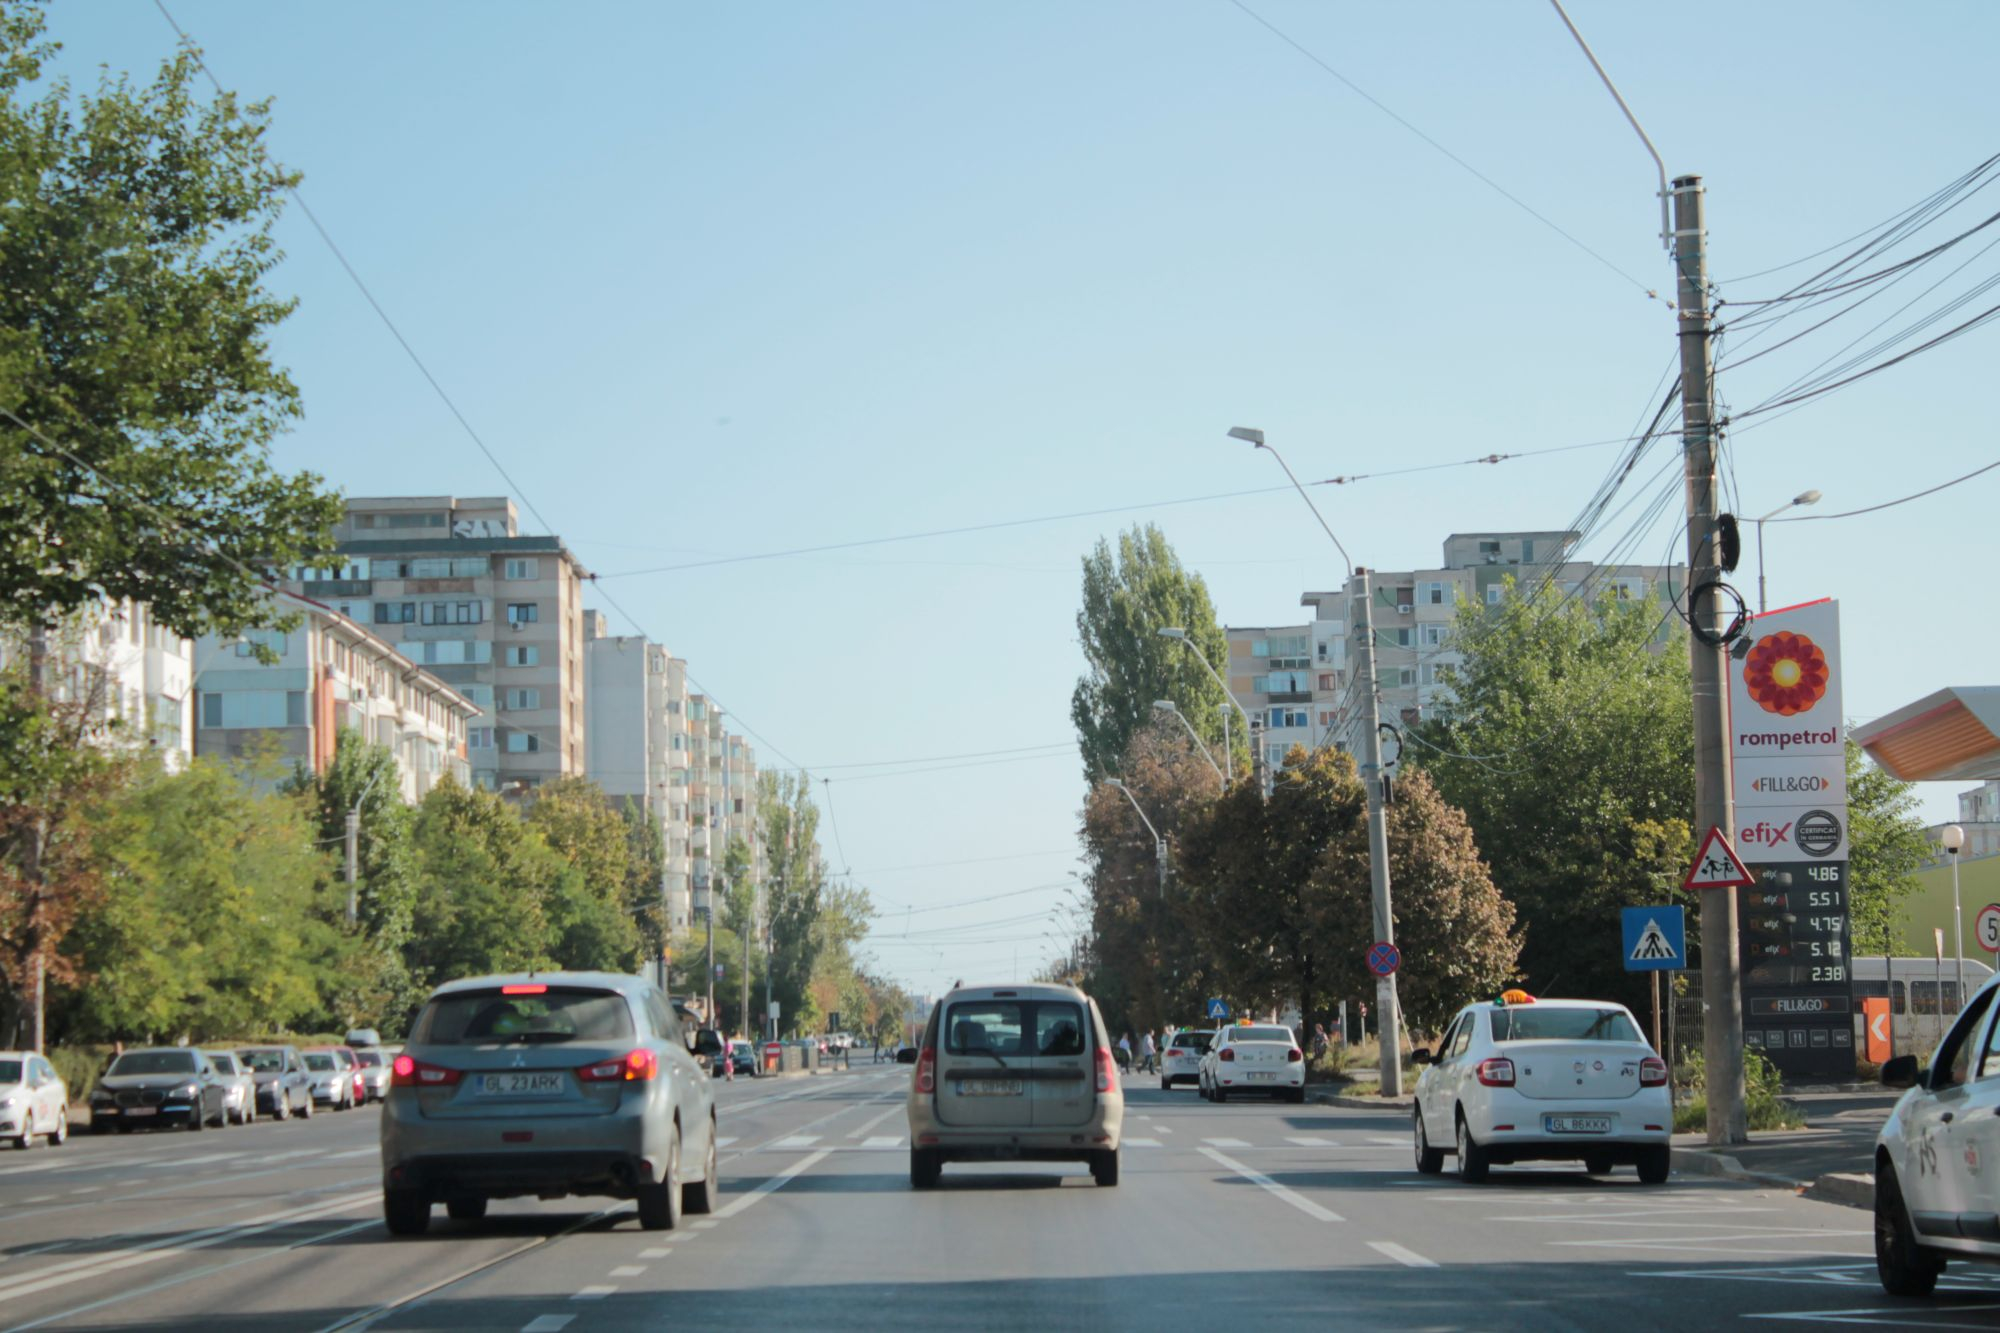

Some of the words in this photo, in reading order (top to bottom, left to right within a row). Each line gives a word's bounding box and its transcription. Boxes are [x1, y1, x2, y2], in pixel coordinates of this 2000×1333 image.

[1740, 727, 1836, 750] rompetrol
[1760, 776, 1820, 792] FILL&GO
[1741, 822, 1792, 847] efix
[1762, 870, 1777, 880] efix
[1808, 866, 1839, 881] 4.86
[1763, 895, 1778, 906] efix
[1764, 919, 1779, 930] efix
[1810, 917, 1841, 931] 4.75
[1765, 944, 1780, 955] efix
[1811, 941, 1842, 957] 5.12
[1812, 966, 1843, 981] 2.38
[1777, 998, 1823, 1012] FILL&GO
[486, 1075, 505, 1091] GL
[1553, 1119, 1569, 1130] GL
